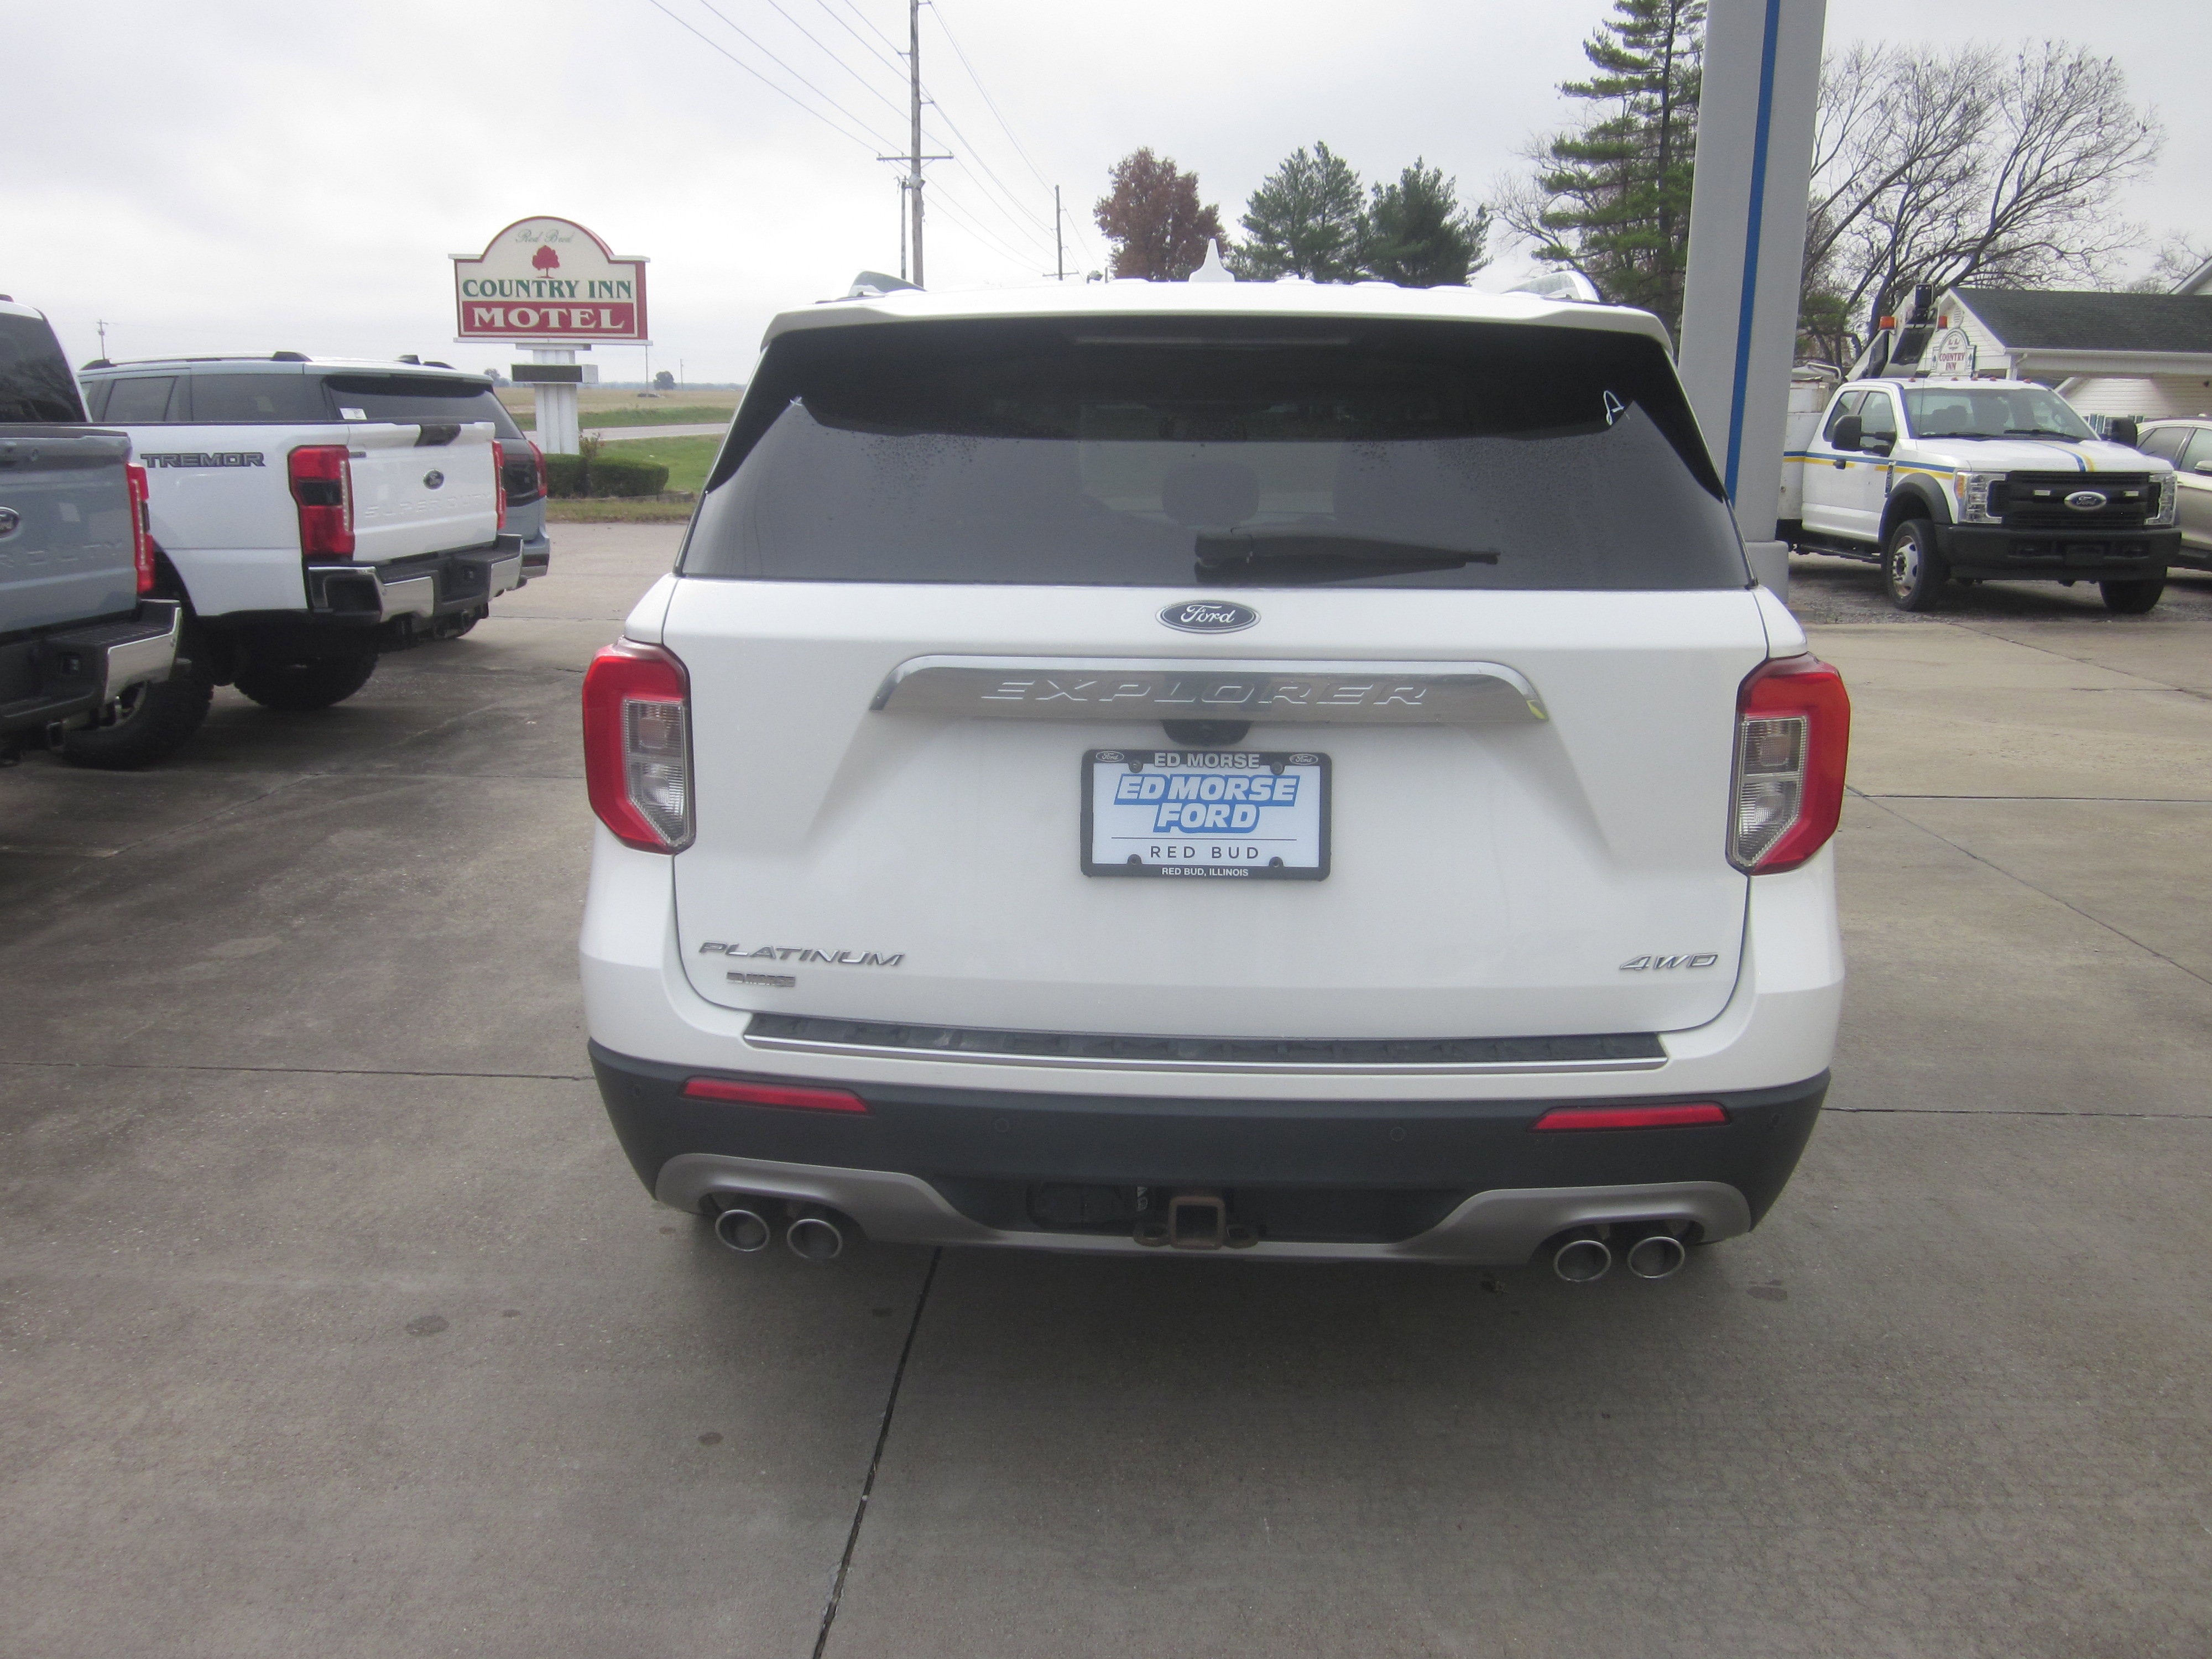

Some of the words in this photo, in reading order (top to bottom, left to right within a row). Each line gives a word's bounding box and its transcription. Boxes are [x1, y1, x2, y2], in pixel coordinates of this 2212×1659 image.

[515, 229, 544, 243] Red
[462, 279, 580, 299] COUNTRY
[588, 280, 632, 299] INN
[472, 307, 625, 329] MOTEL
[1939, 352, 1965, 362] COUNTRY
[1945, 362, 1957, 371] INN
[140, 452, 267, 468] TREMOR
[364, 499, 441, 518] SUPER
[1180, 604, 1236, 623] Ford
[980, 679, 1428, 705] EXPLORER
[1154, 753, 1181, 768] ED
[1187, 753, 1260, 769] MORSE
[1116, 775, 1166, 800] ED
[1167, 776, 1297, 801] MORSE
[1156, 804, 1260, 829] FORD
[1150, 846, 1196, 858] RED
[1212, 847, 1259, 859] BUD
[1161, 867, 1182, 875] RED
[1184, 868, 1207, 877] BUD,
[1209, 868, 1249, 877] ILLINOIS
[699, 941, 905, 966] PLATINUM
[1619, 952, 1719, 971] 4WD
